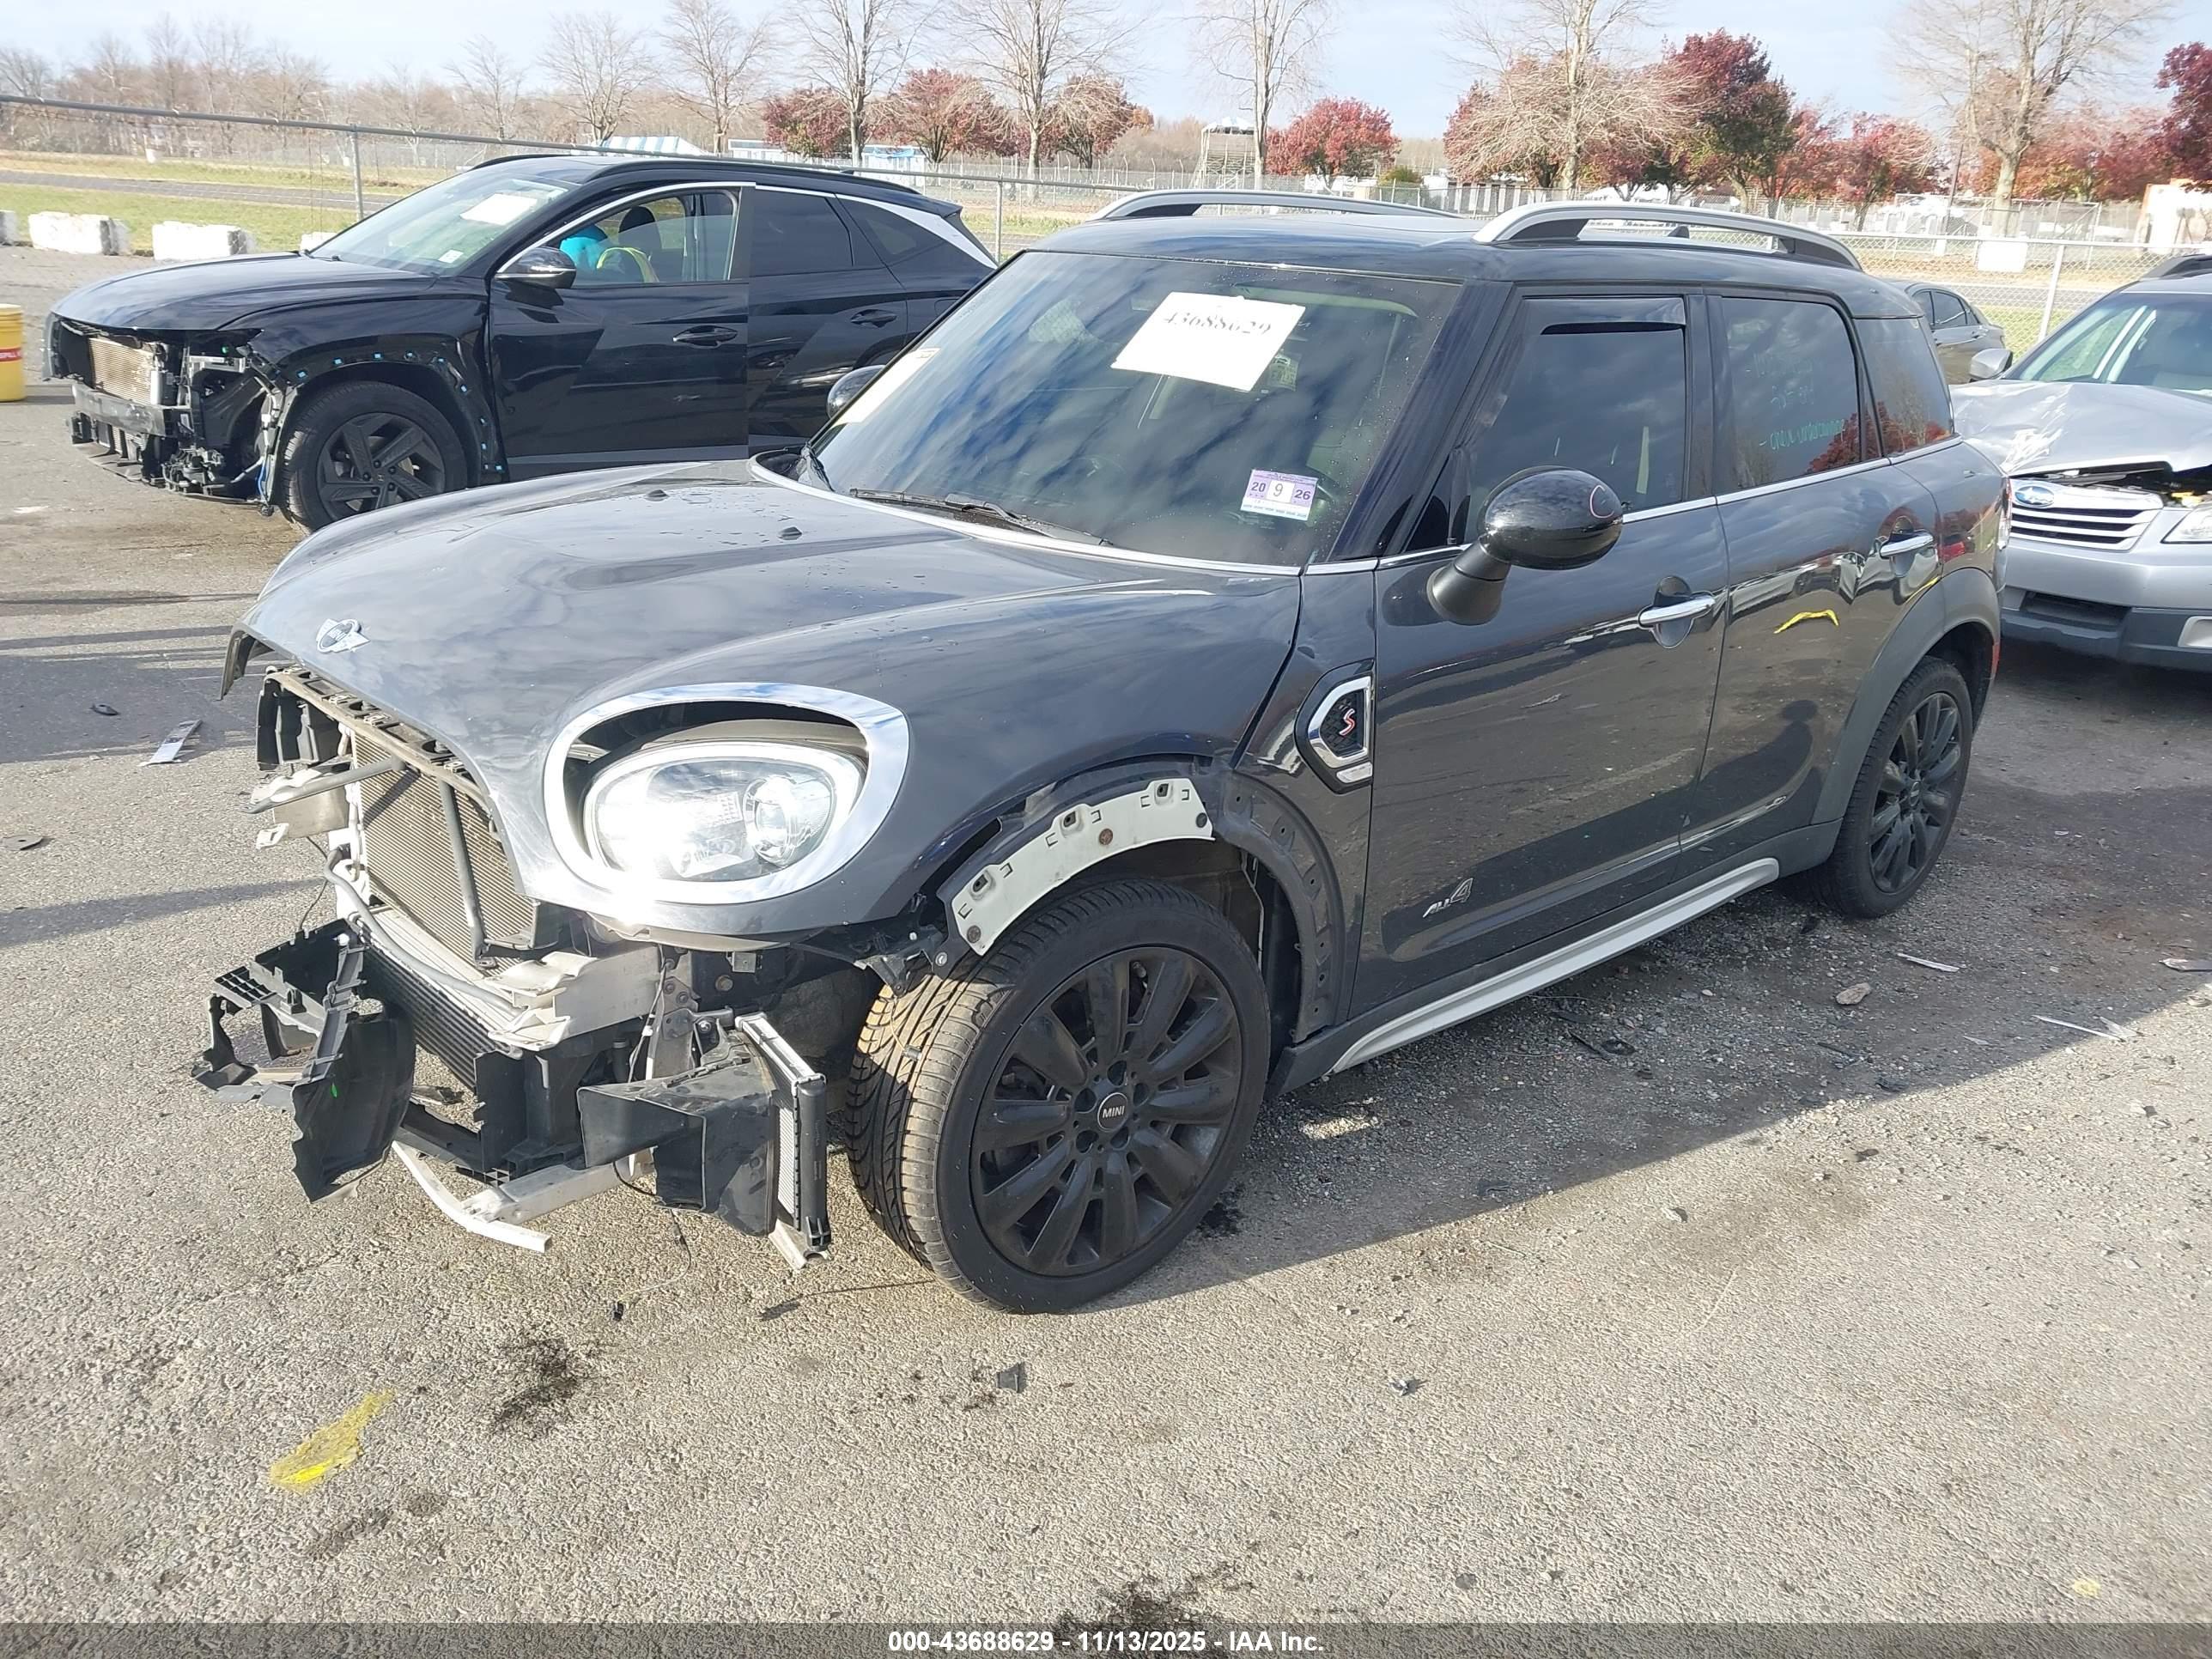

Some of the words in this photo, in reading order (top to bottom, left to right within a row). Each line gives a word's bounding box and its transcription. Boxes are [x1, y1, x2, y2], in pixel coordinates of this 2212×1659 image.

[1250, 482, 1267, 493] 20
[1273, 483, 1284, 497] 9
[1294, 489, 1311, 501] 26
[1339, 708, 1357, 737] S
[1102, 1105, 1125, 1119] MINI
